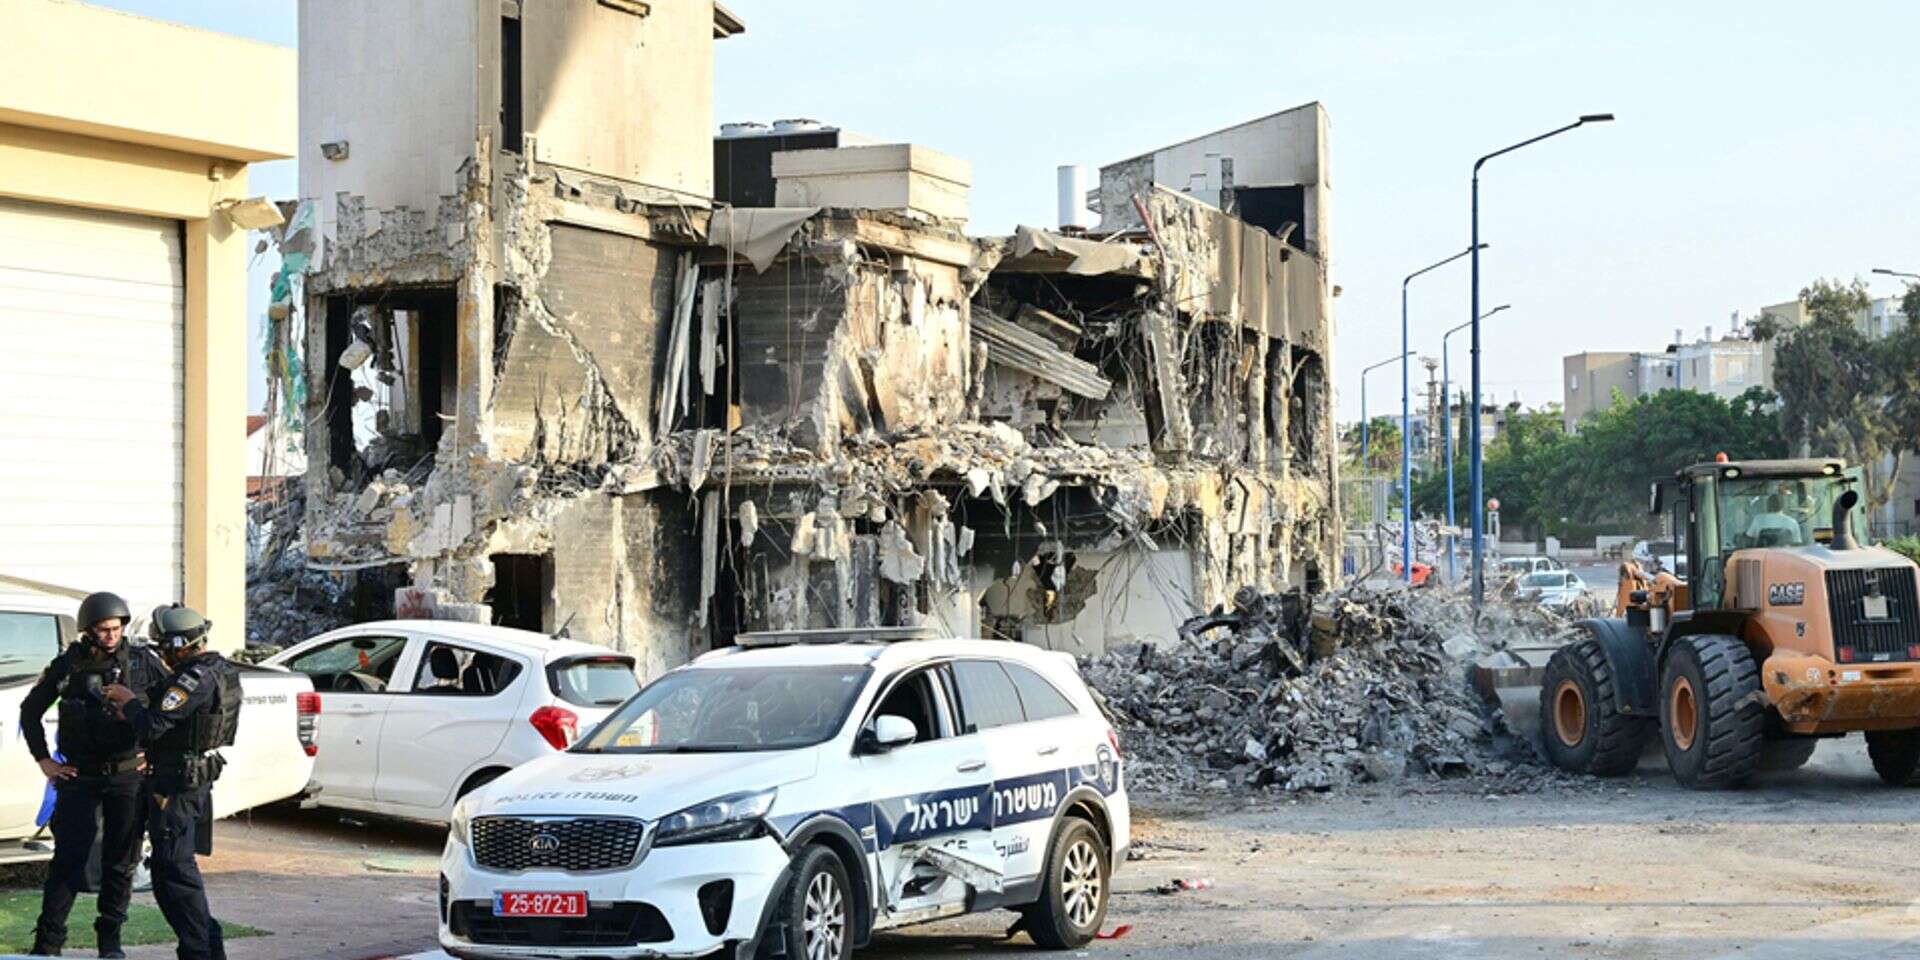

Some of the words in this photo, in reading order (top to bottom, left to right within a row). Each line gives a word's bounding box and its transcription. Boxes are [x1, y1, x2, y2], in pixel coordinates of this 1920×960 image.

[1769, 583, 1804, 605] CASE
[904, 797, 979, 833] ישראל
[531, 835, 553, 849] KIA
